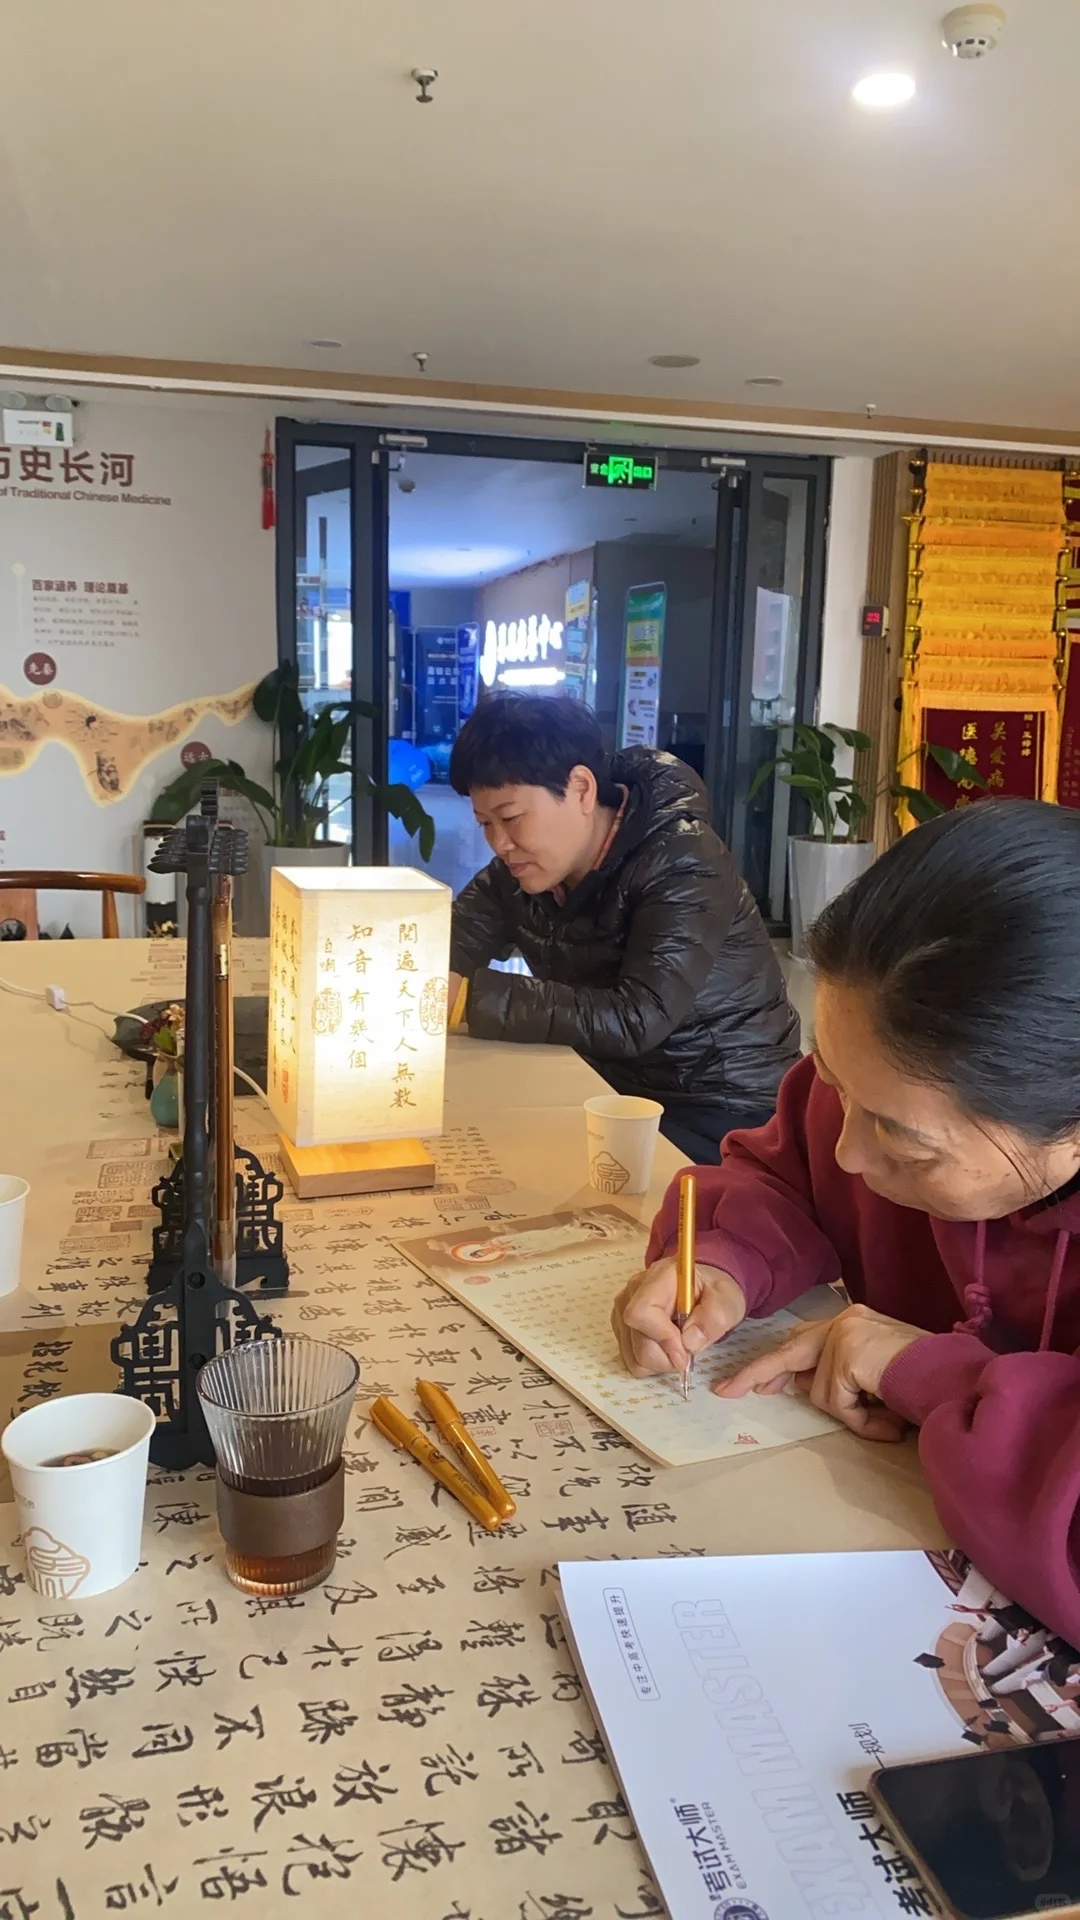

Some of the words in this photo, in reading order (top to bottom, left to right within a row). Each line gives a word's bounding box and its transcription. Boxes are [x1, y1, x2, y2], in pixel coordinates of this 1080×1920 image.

[0, 446, 136, 488] 史长河
[11, 486, 71, 501] Traditional
[73, 489, 119, 503] Chinese
[121, 493, 171, 506] Medicine
[701, 1801, 730, 1851] MASTER
[724, 1853, 748, 1889] EXAM
